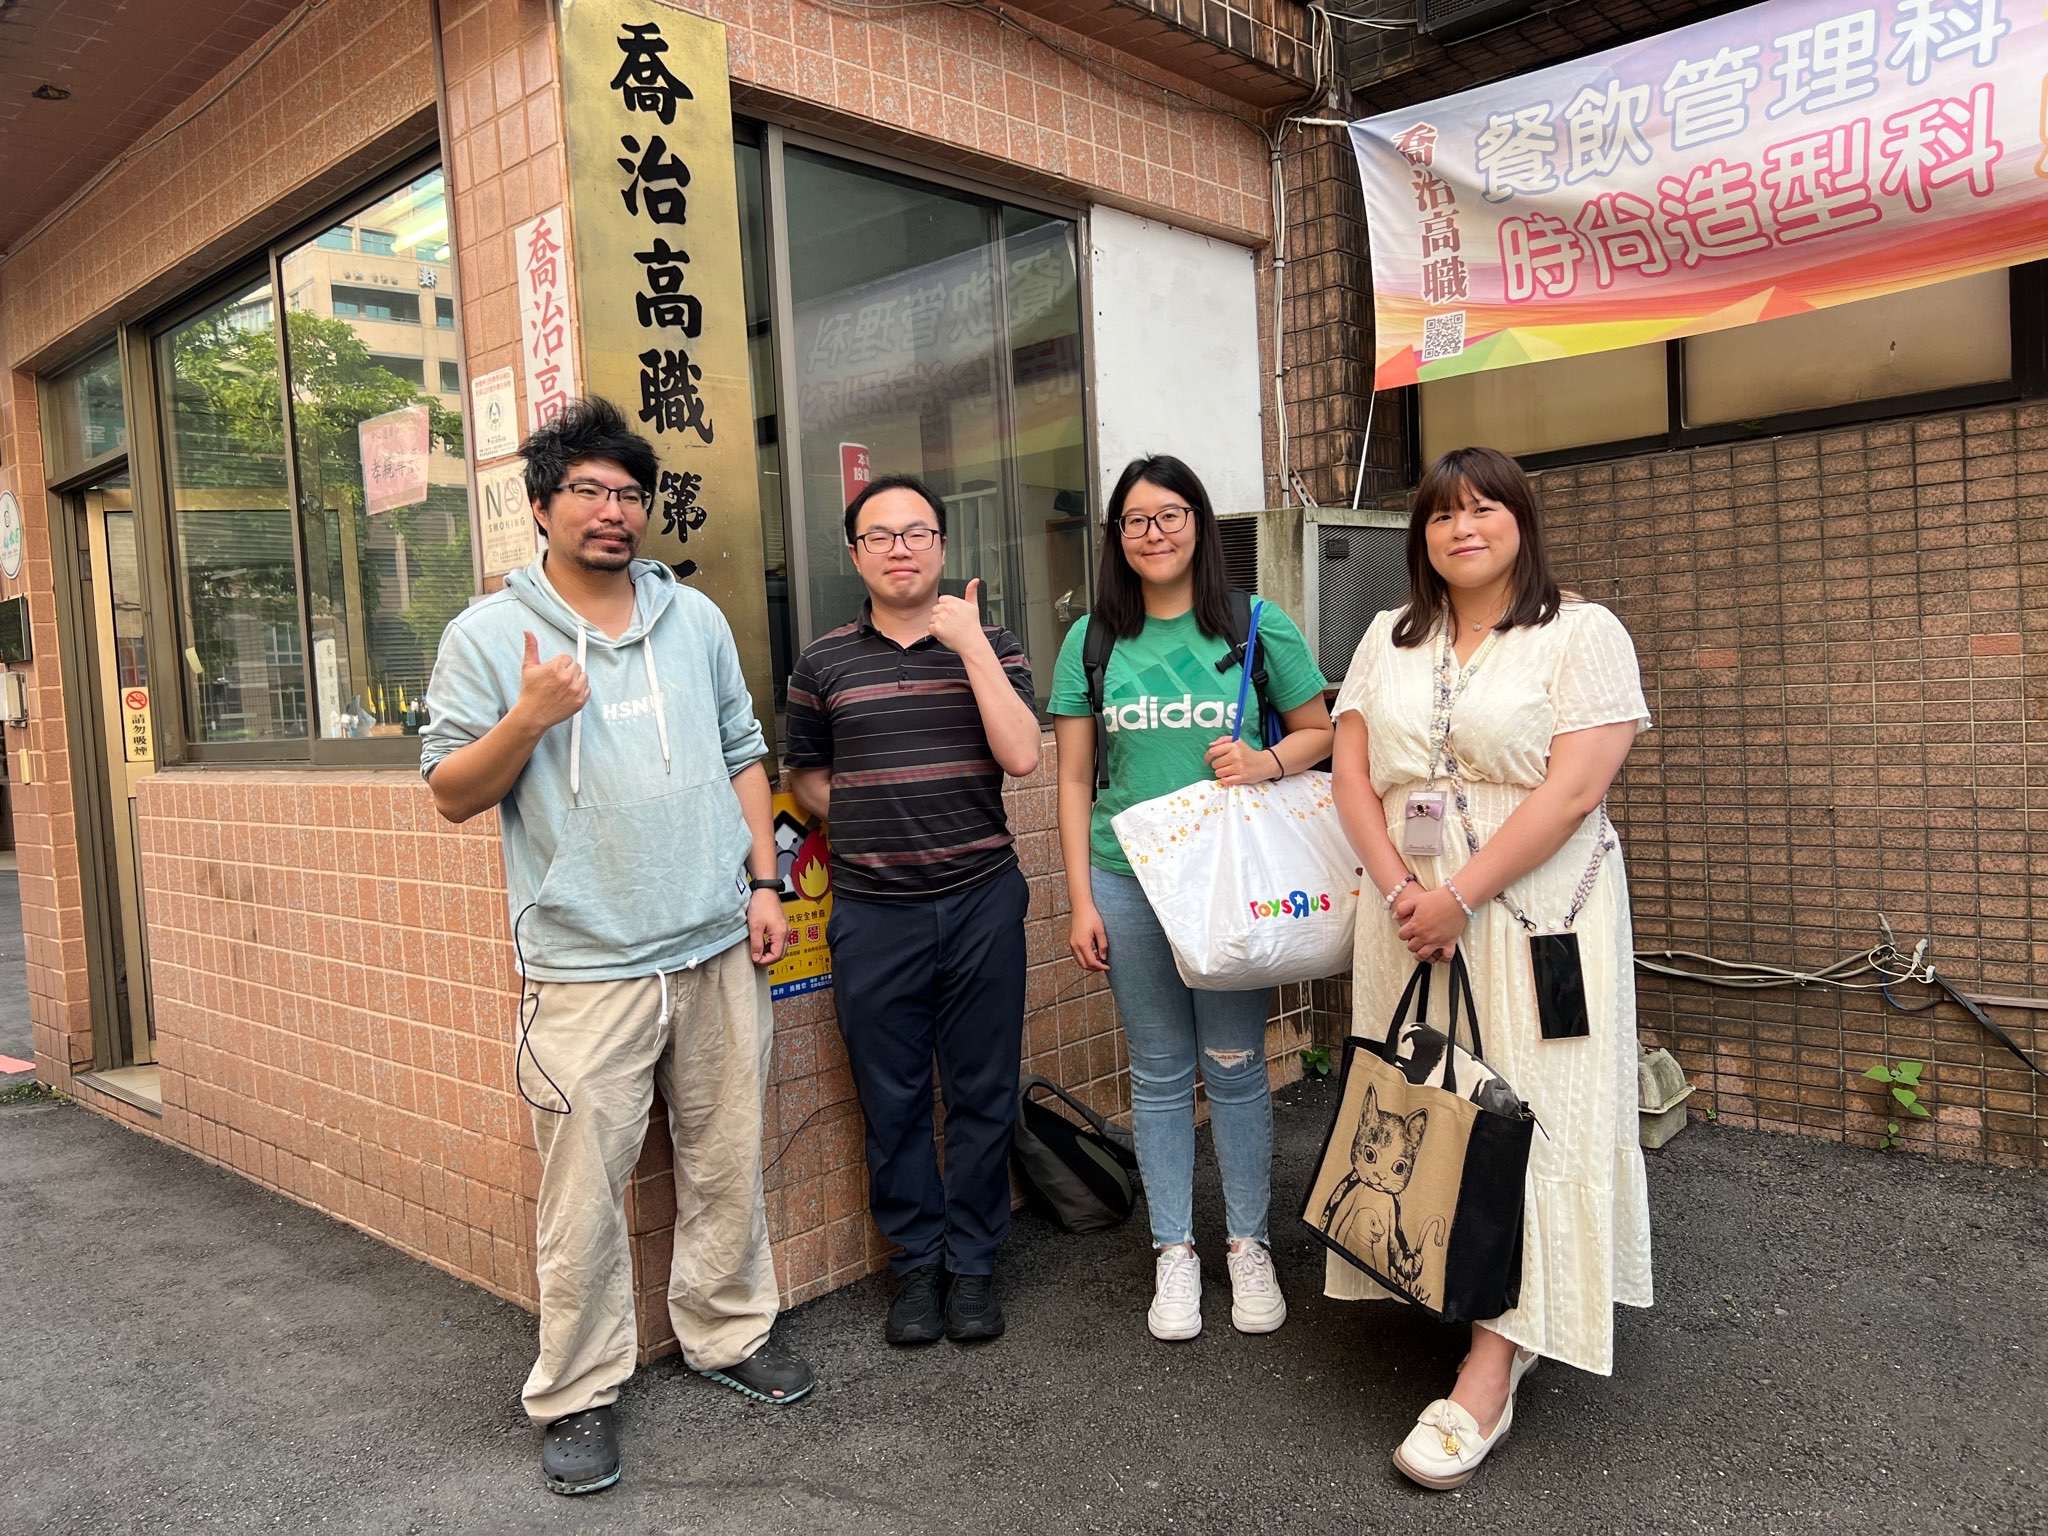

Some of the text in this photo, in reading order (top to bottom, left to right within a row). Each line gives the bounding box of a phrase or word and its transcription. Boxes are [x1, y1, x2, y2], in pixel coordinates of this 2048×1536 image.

[1472, 0, 2012, 206] 餐飲管理科
[1496, 82, 2005, 306] 時尚造型科
[610, 22, 714, 445] 喬治高職
[1391, 120, 1471, 306] 喬治高職
[603, 695, 655, 720] HSN
[1102, 693, 1244, 733] adidas
